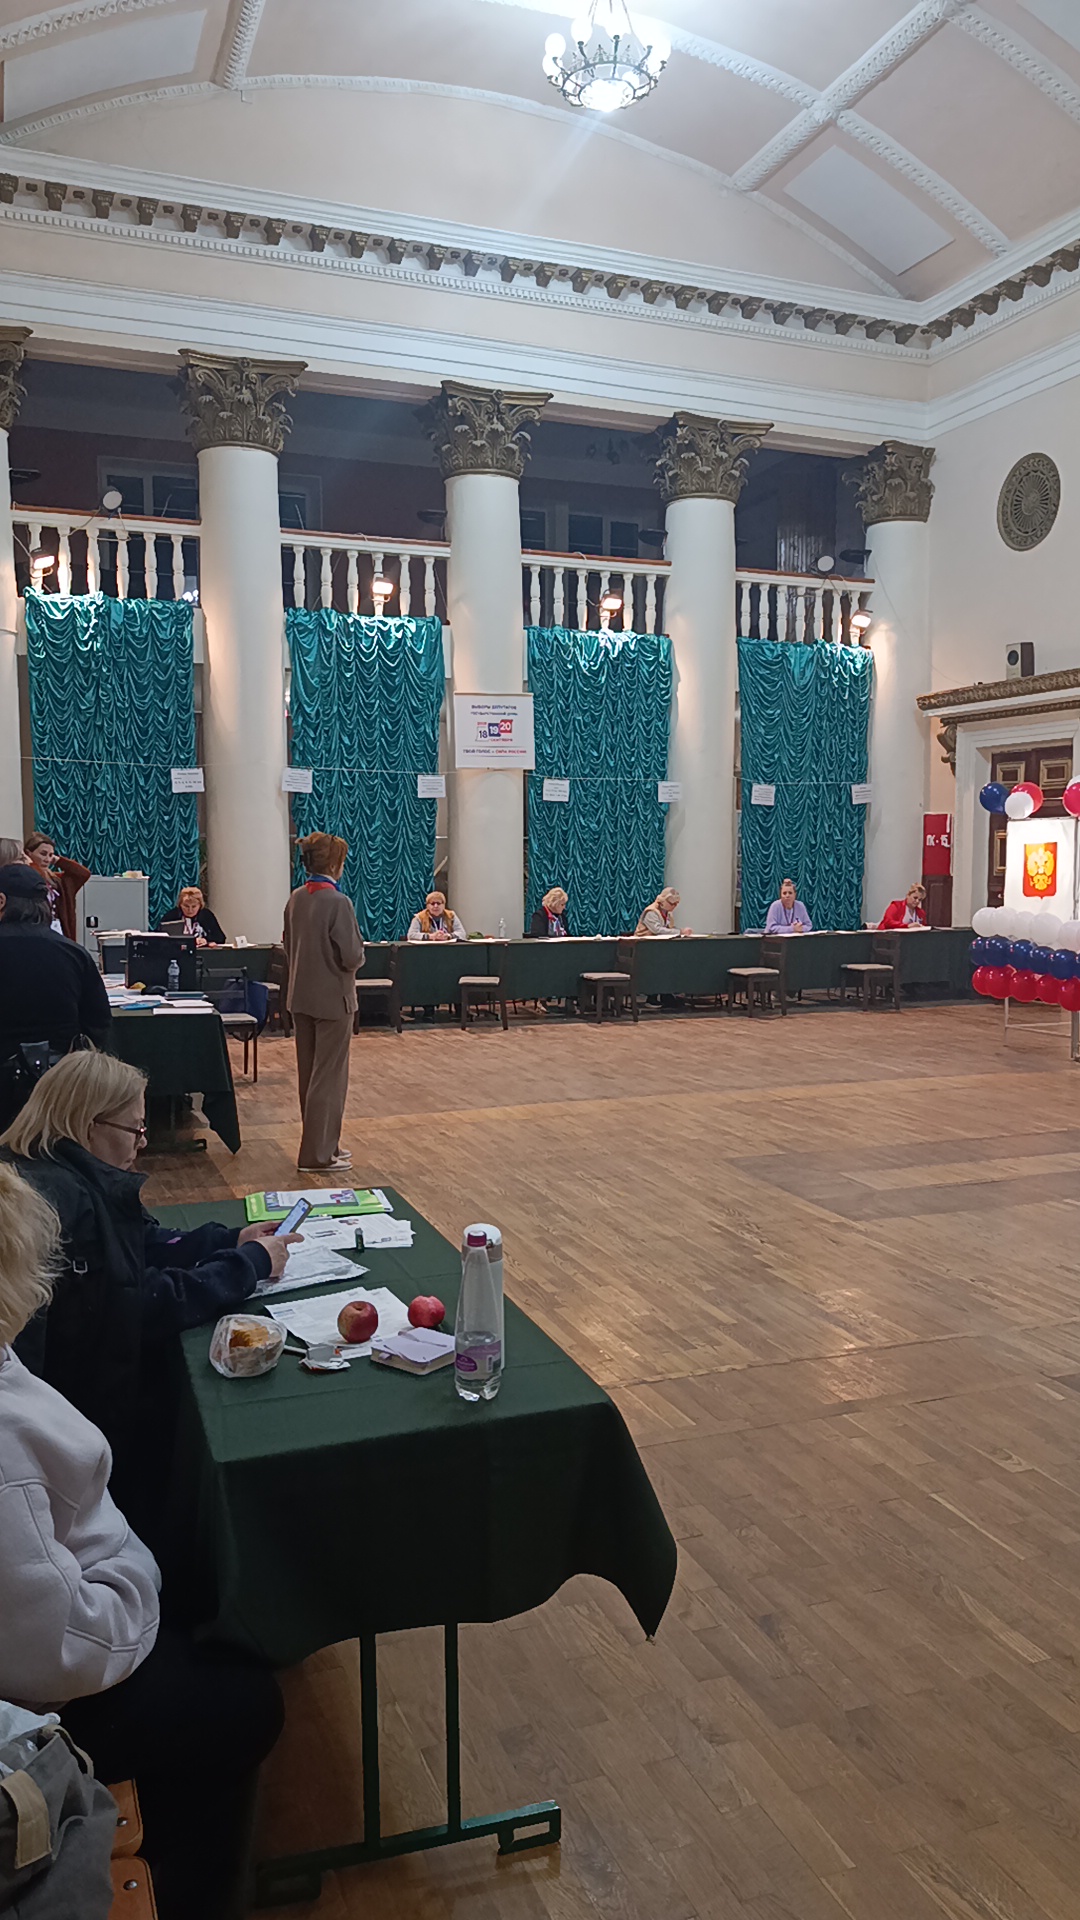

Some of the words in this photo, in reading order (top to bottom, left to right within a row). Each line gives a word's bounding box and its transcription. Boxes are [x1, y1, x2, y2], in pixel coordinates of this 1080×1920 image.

[490, 725, 499, 735] 19
[500, 721, 511, 731] 20
[479, 730, 488, 739] 18
